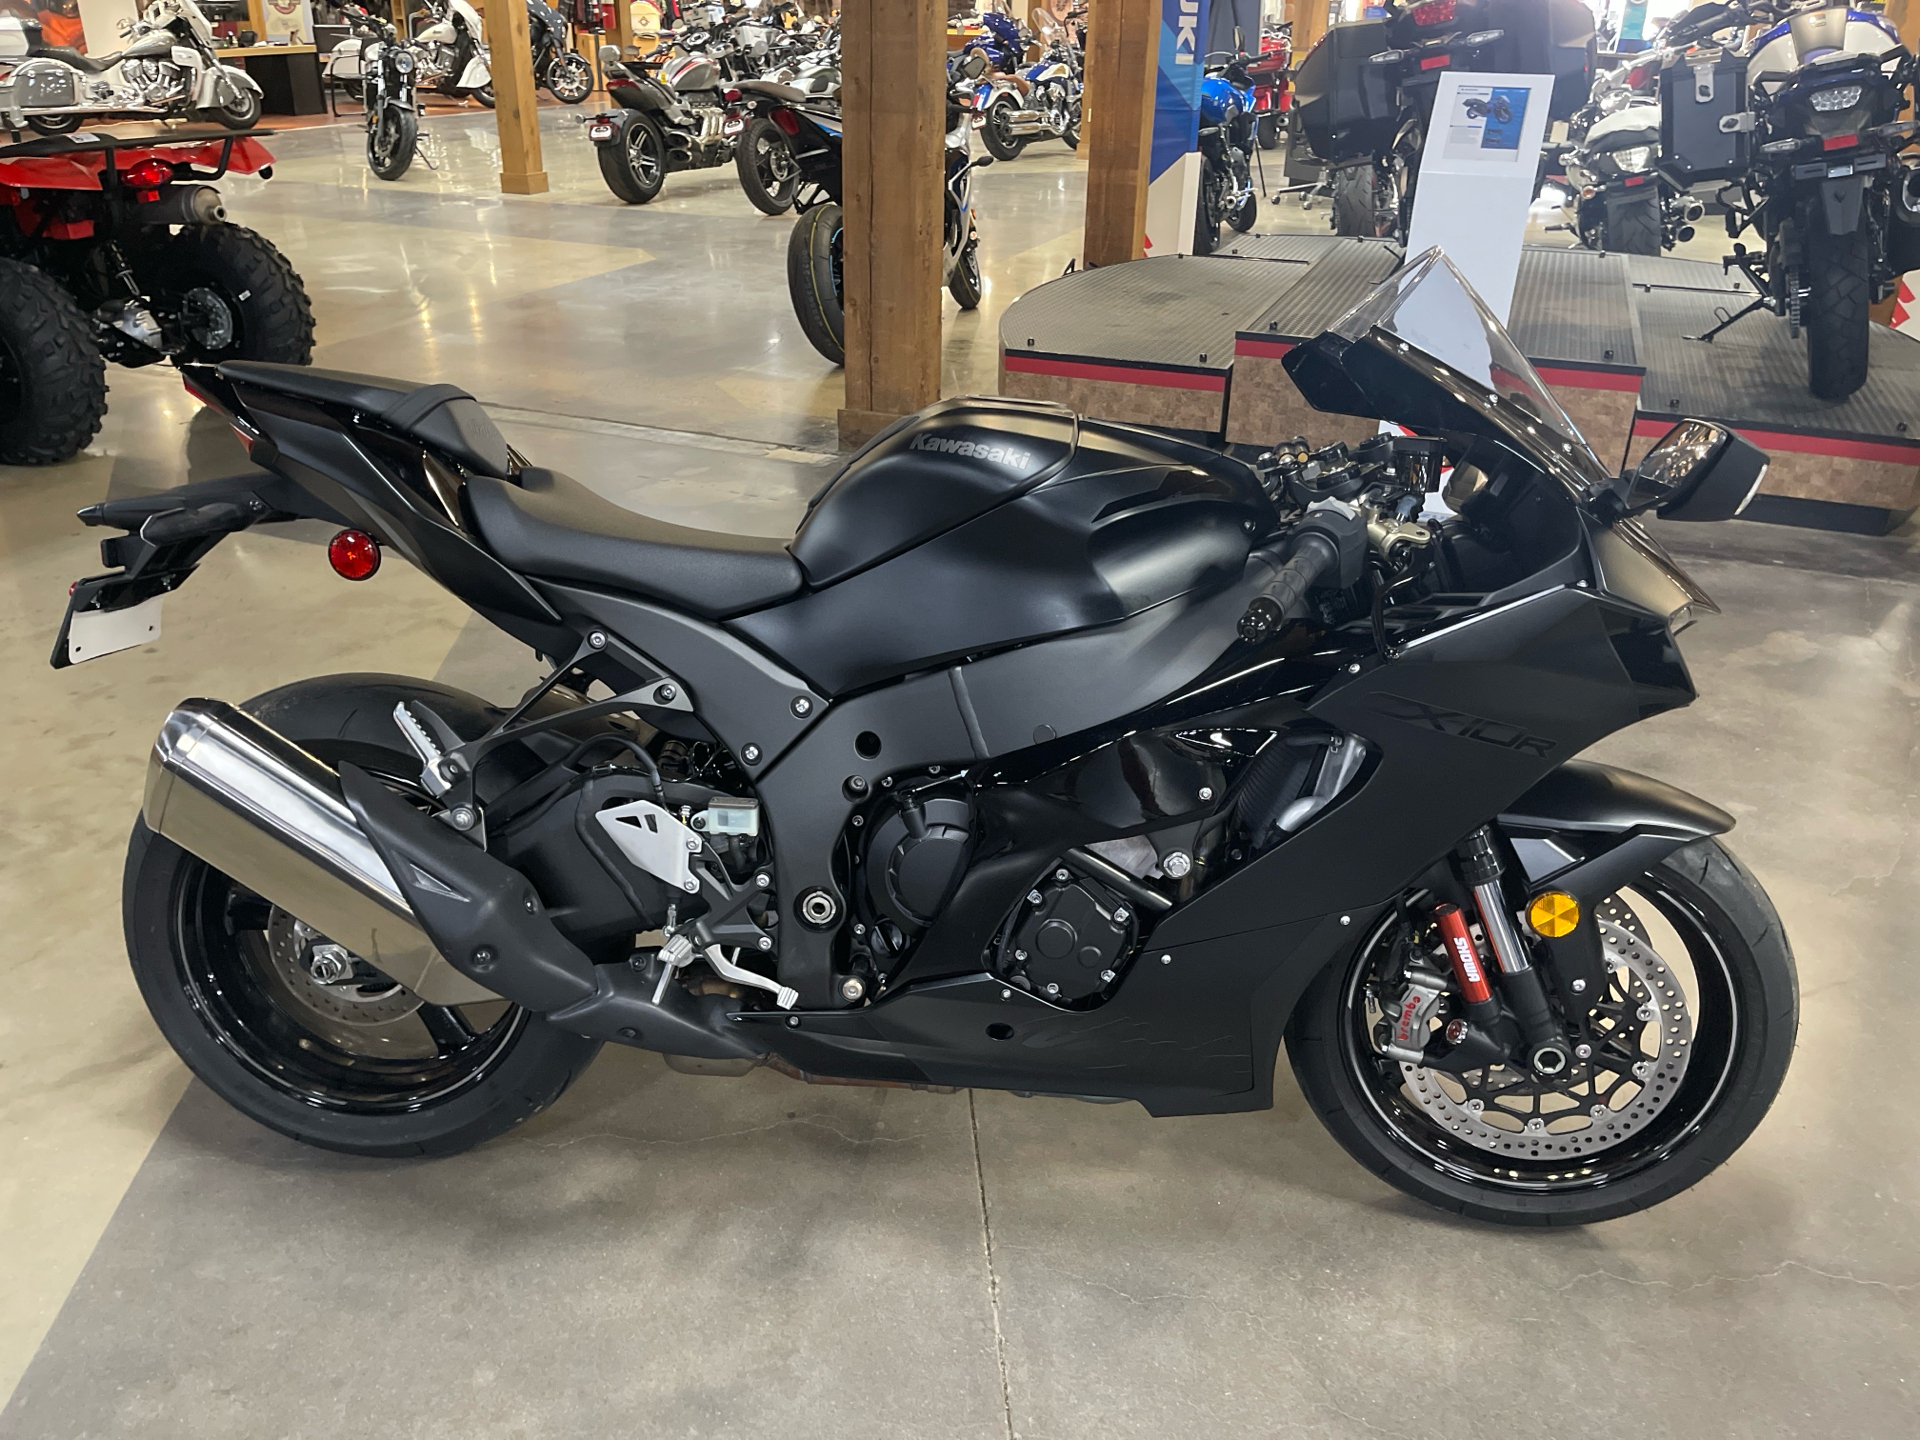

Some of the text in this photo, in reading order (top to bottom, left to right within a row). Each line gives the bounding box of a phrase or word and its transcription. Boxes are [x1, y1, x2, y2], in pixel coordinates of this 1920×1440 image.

[909, 433, 1031, 470] Kawasaki
[1453, 936, 1481, 982] SHOWA
[1397, 995, 1421, 1041] brembo
